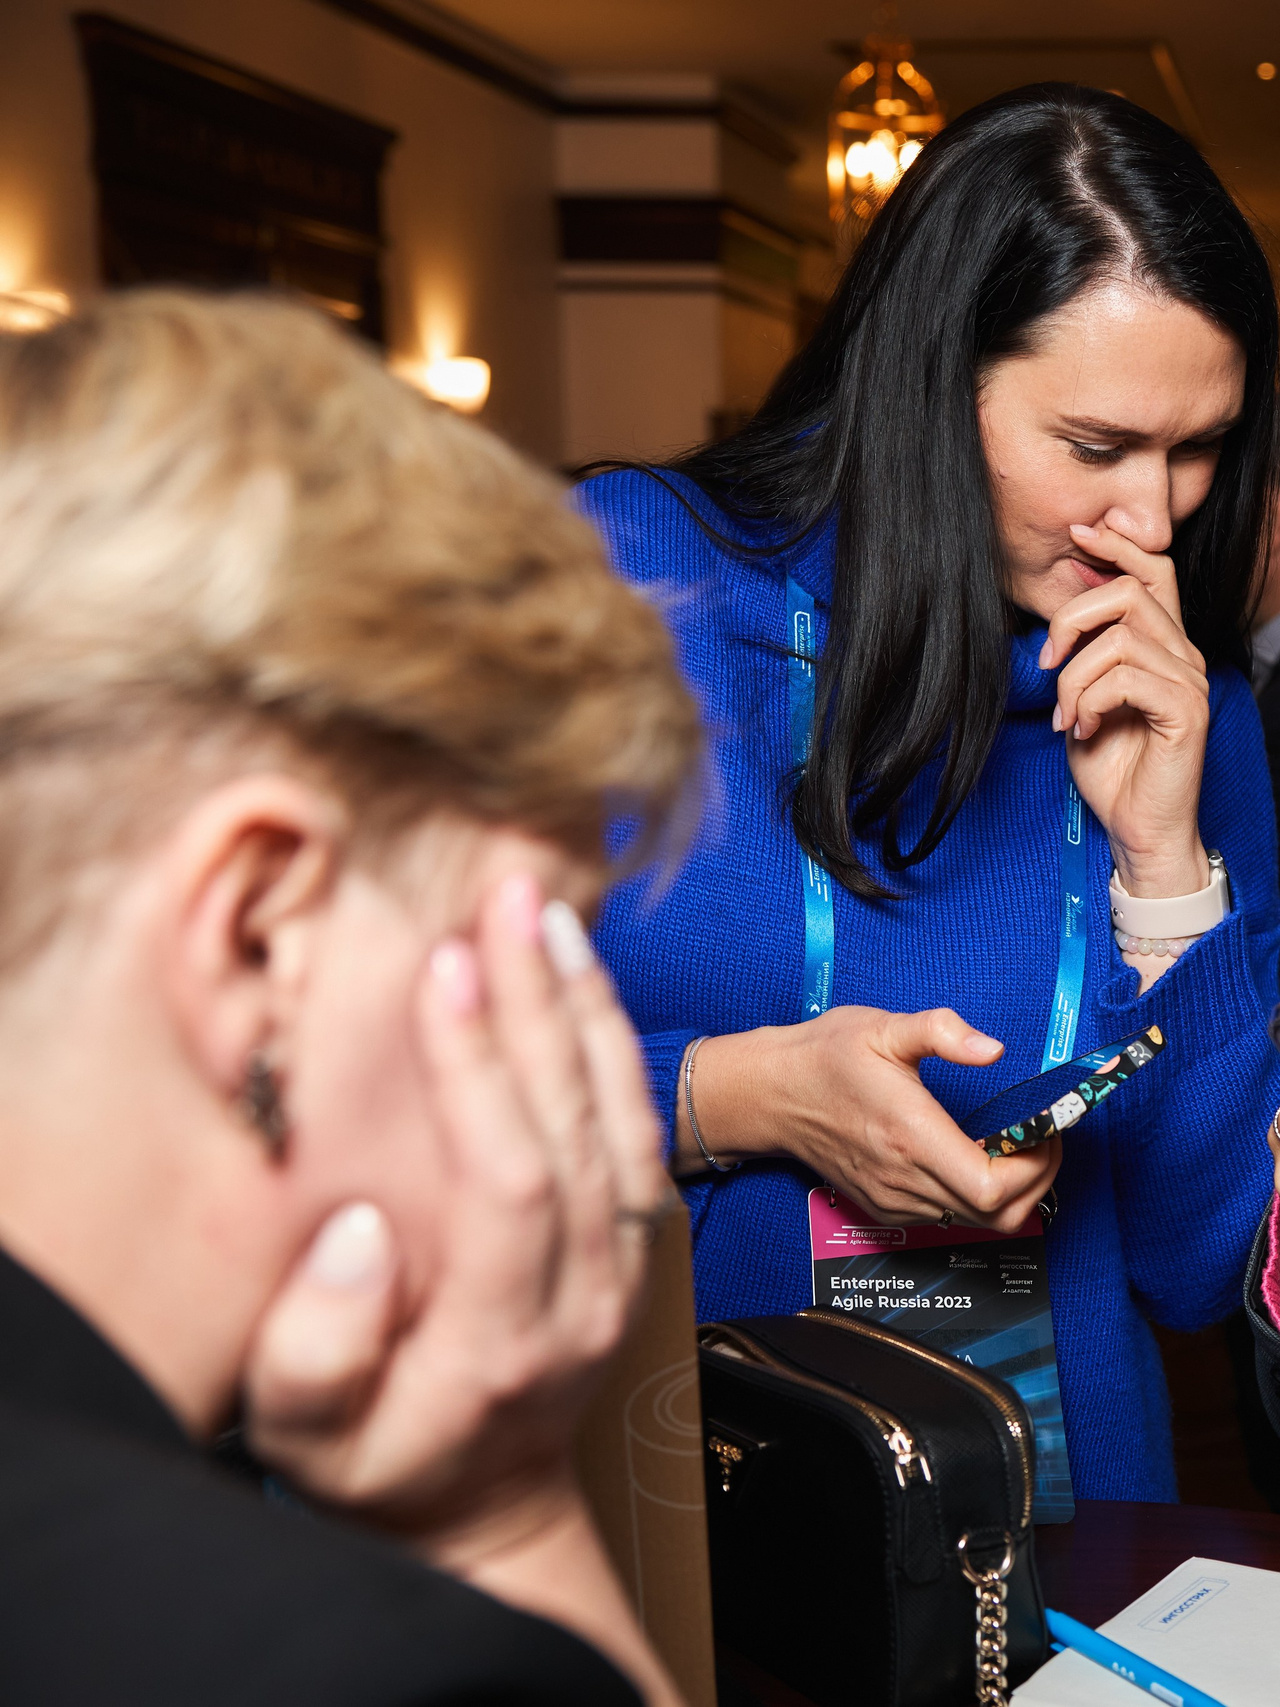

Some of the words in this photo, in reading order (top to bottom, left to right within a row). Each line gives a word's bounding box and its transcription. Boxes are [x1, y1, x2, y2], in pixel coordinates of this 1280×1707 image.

[1057, 1013, 1069, 1048] Enterprise
[851, 1230, 891, 1239] Enterprise
[830, 1276, 915, 1292] Enterprise
[831, 1294, 874, 1311] Agile
[878, 1295, 930, 1308] Russia
[934, 1296, 972, 1309] 2023
[1158, 1587, 1212, 1625] ИНГОССТРАХ
